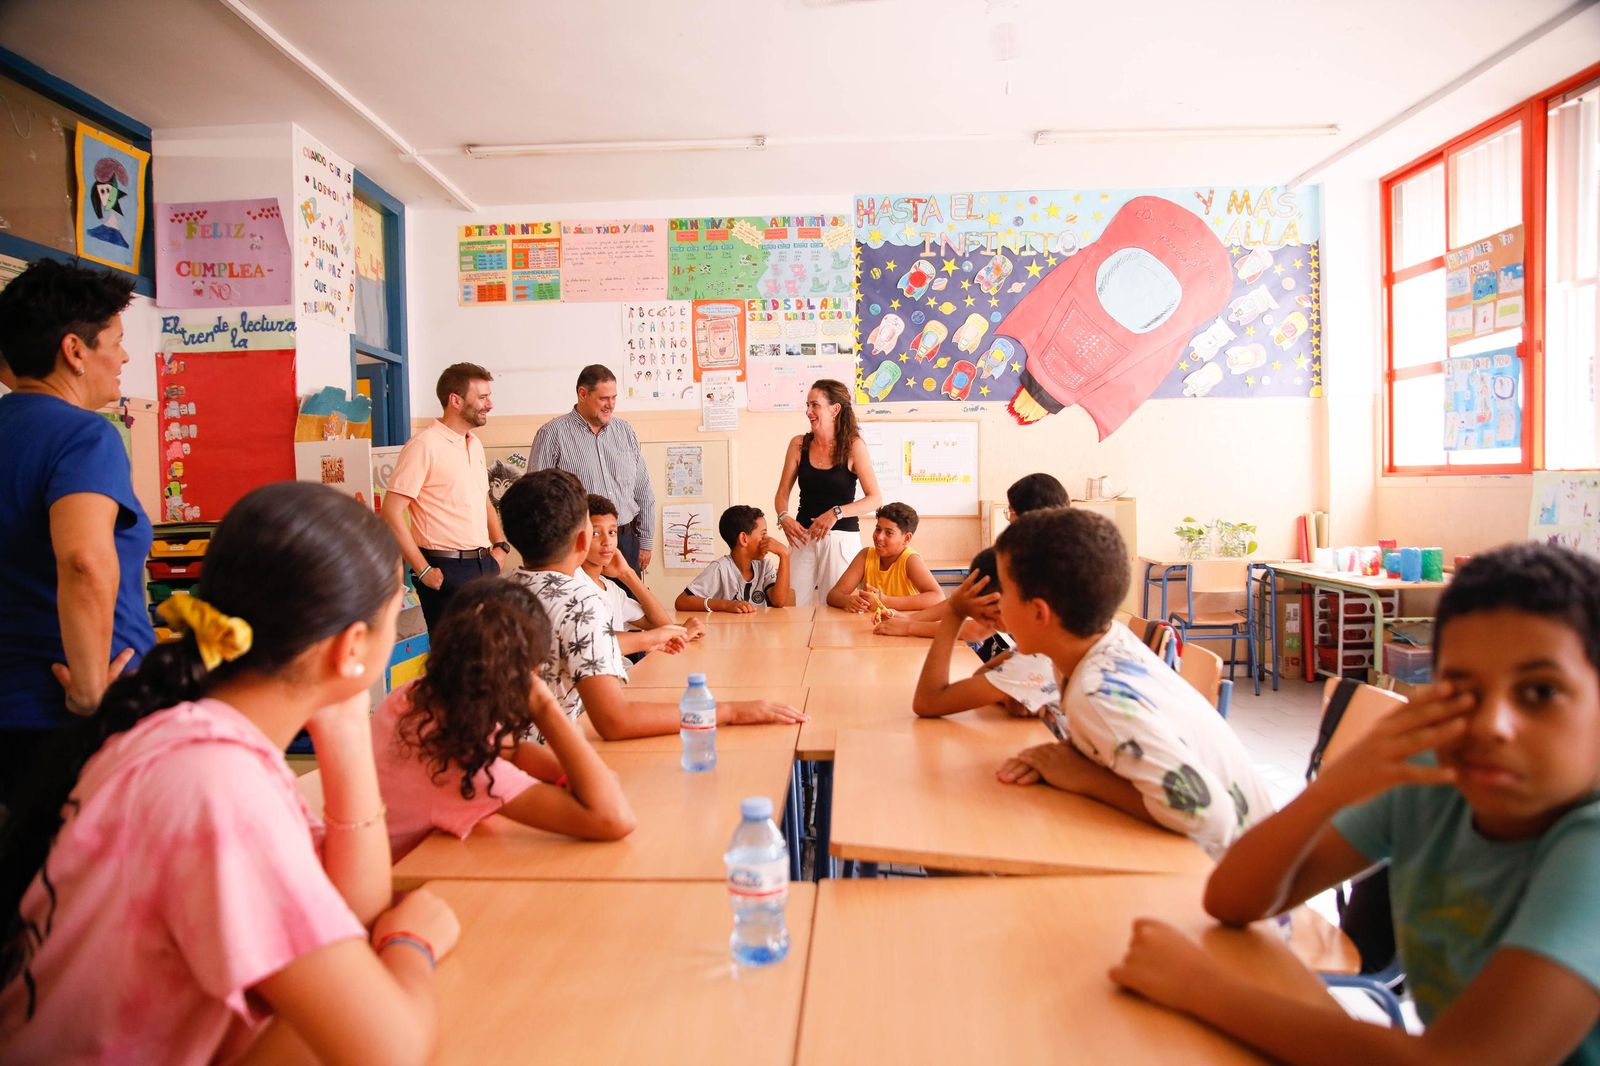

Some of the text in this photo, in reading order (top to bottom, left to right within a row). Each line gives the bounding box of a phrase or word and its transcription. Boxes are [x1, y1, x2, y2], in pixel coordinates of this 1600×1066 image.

[313, 177, 326, 195] LOS
[856, 193, 984, 228] HASTA EL
[1194, 188, 1215, 215] Y
[185, 221, 247, 241] FELIZ
[623, 224, 630, 234] Y
[920, 230, 1079, 257] INFINITO
[313, 279, 327, 293] QUE
[161, 311, 297, 348] El tren de la lectura
